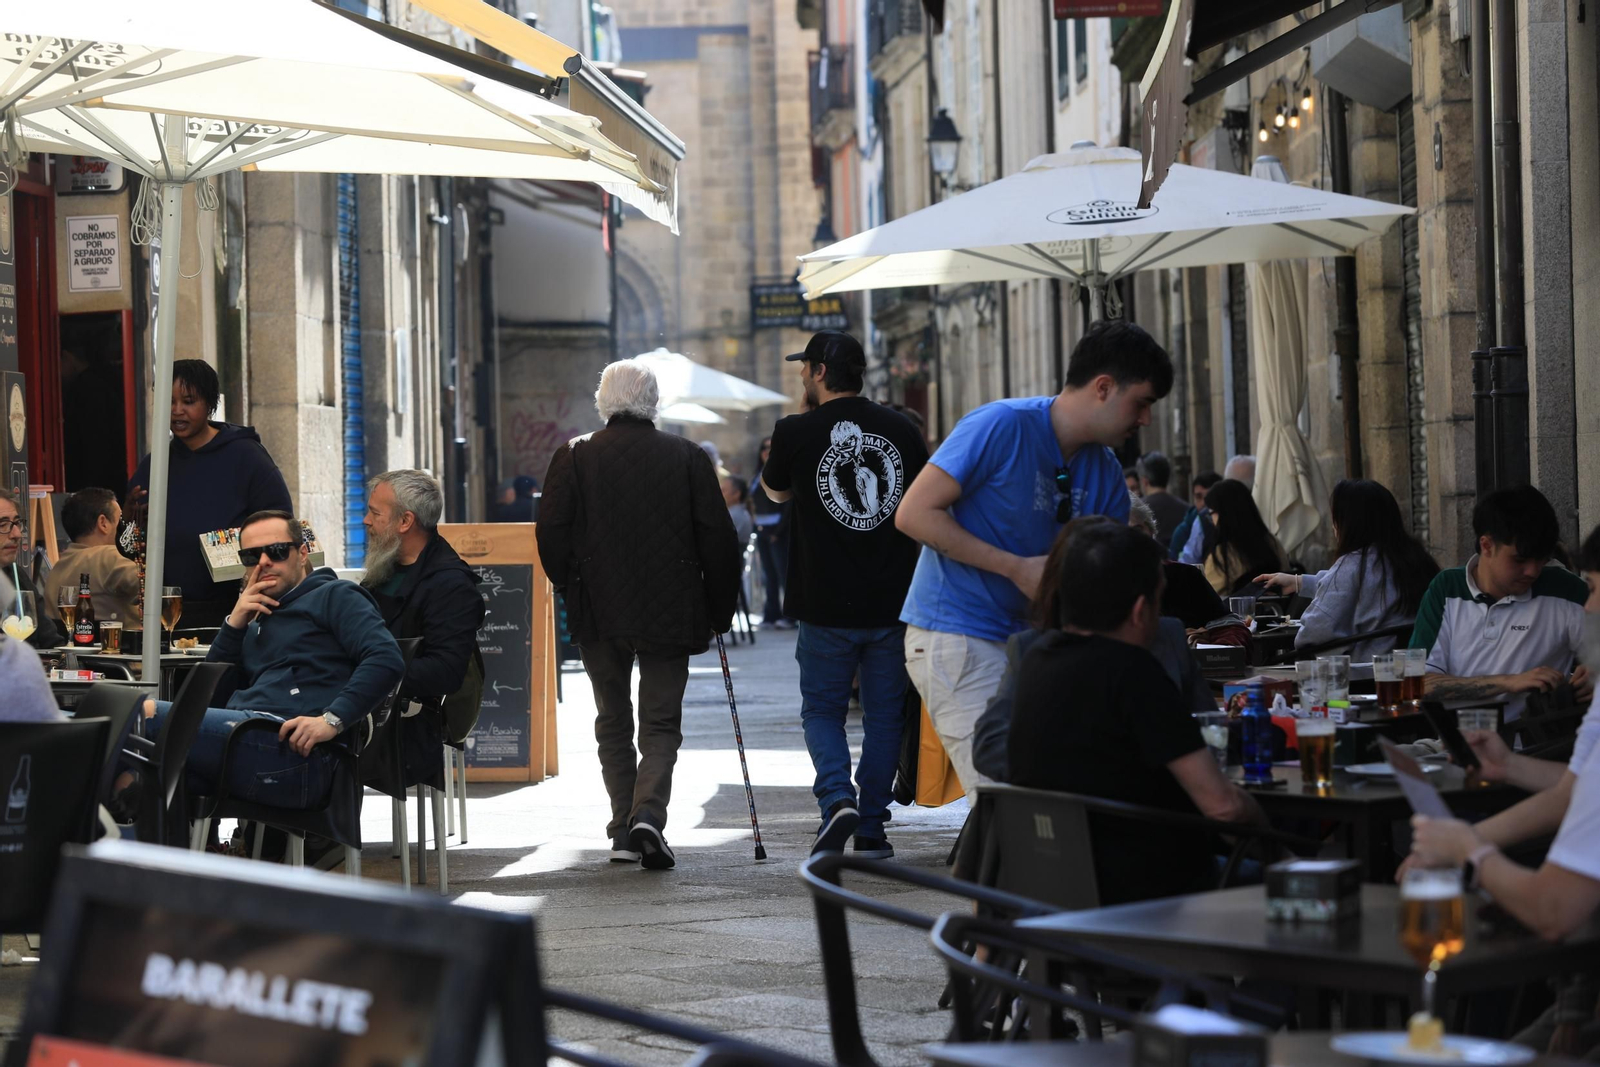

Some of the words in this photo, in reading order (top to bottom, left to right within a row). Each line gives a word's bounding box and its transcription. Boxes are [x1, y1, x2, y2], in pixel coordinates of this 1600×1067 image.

[72, 231, 116, 241] COBRAMOS
[73, 258, 79, 266] A
[81, 257, 113, 266] GRUPOS
[74, 248, 115, 257] SEPARADO
[864, 436, 887, 449] MAY
[820, 450, 837, 473] WAY
[886, 446, 900, 467] THE
[819, 475, 830, 497] THE
[882, 469, 902, 515] BRIDGES
[825, 498, 850, 524] LIGHT
[851, 517, 878, 528] BURN
[141, 952, 374, 1036] BARALLETE
